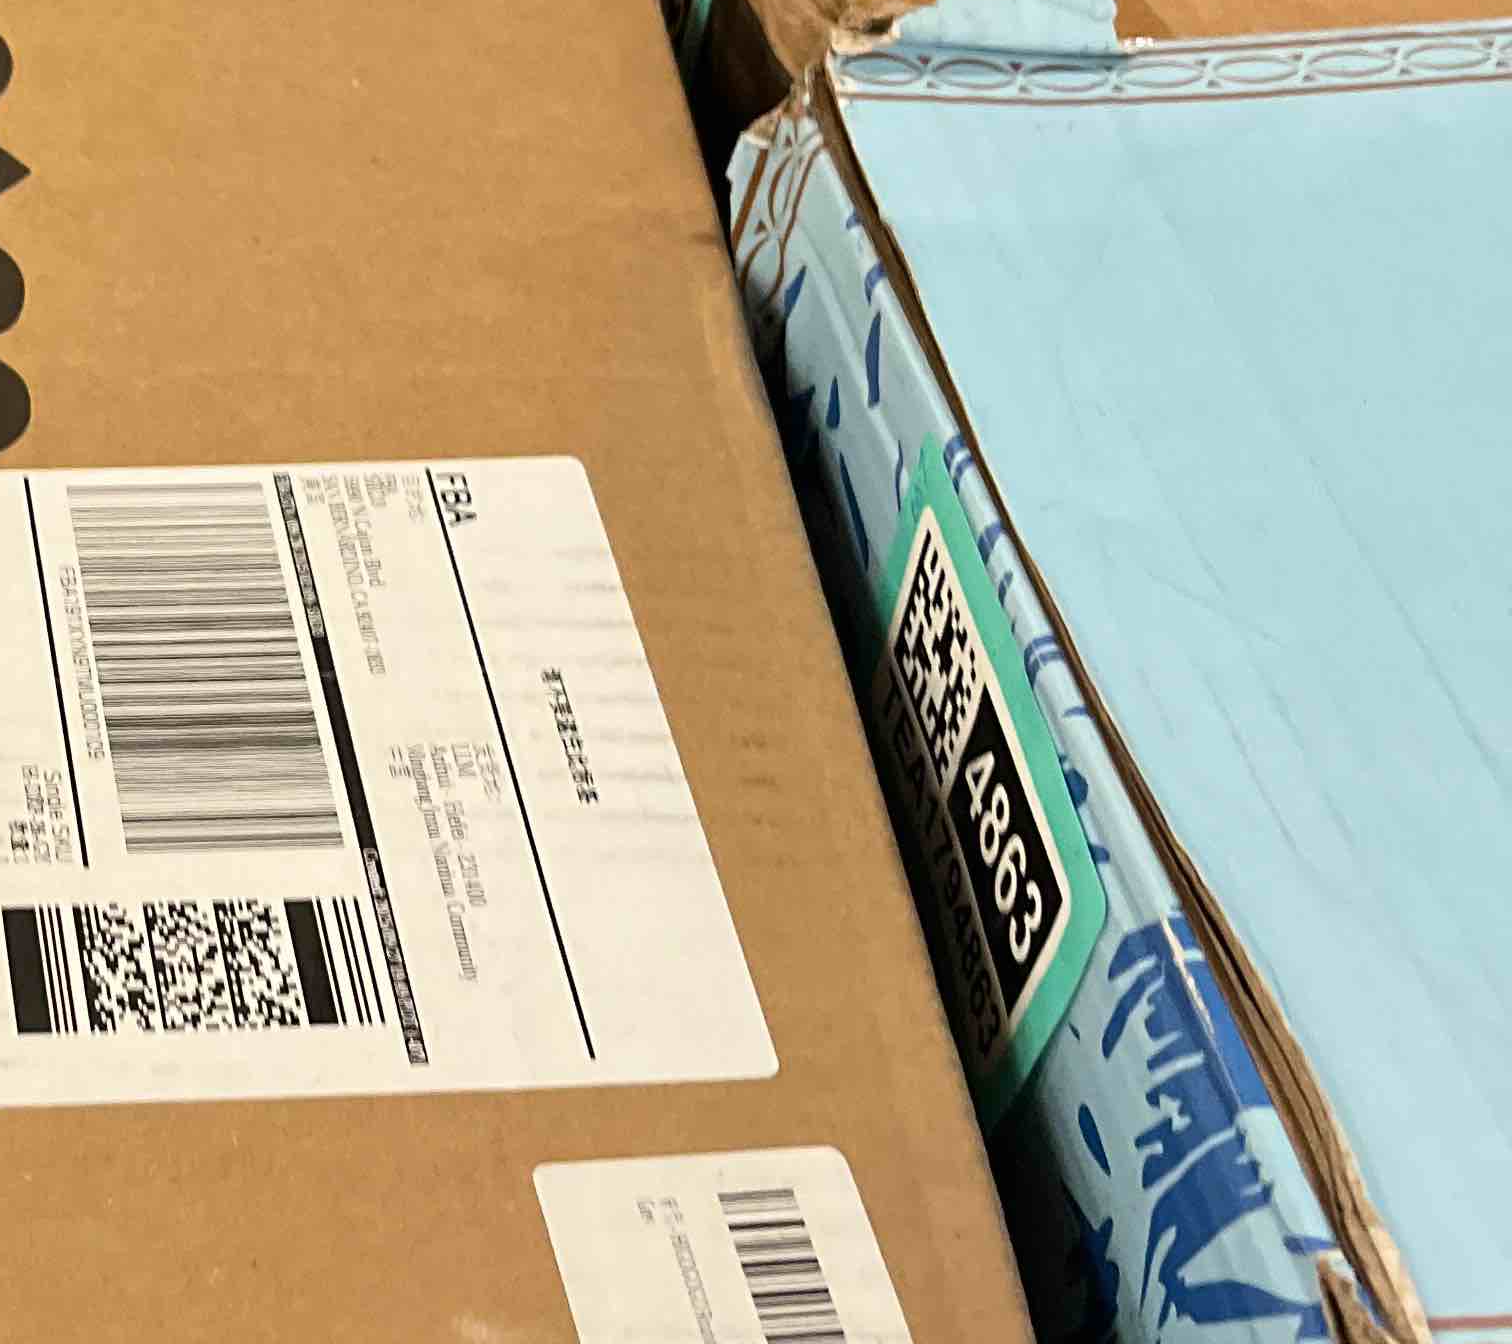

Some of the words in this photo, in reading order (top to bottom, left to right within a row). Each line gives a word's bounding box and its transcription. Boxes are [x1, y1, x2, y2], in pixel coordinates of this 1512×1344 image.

[437, 472, 477, 527] FBA
[965, 750, 1042, 963] 4863
[445, 901, 478, 982] Community
